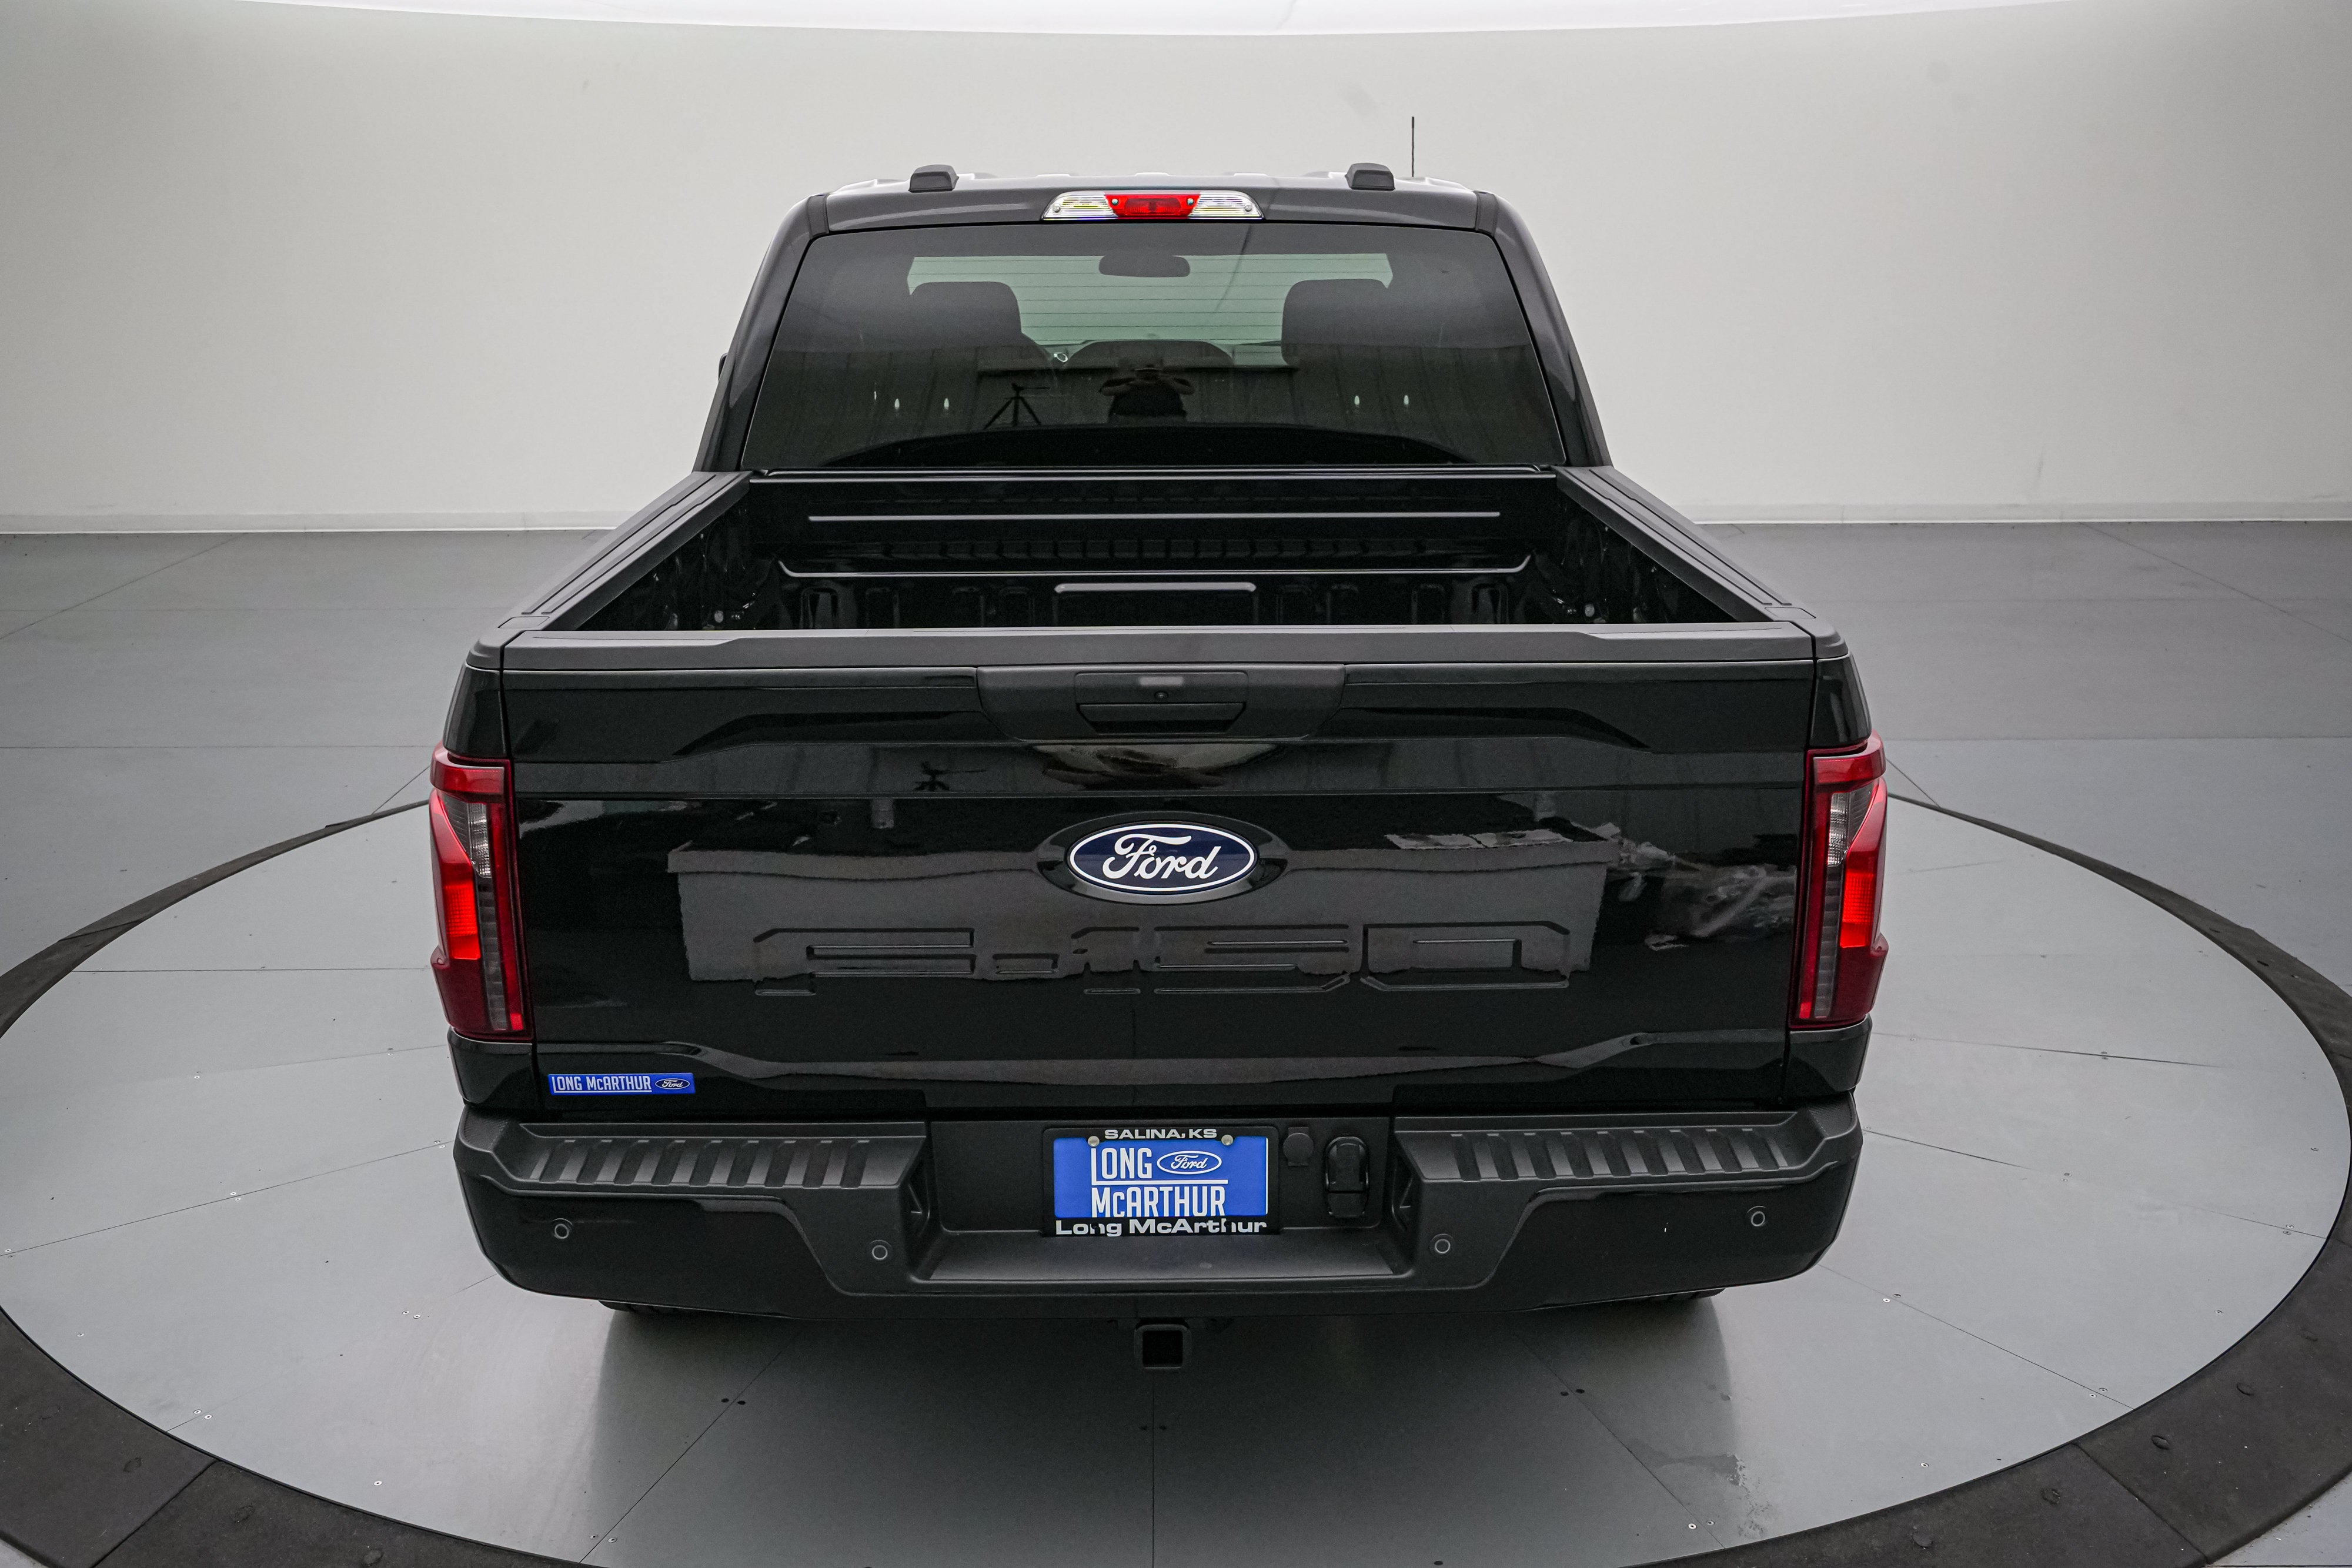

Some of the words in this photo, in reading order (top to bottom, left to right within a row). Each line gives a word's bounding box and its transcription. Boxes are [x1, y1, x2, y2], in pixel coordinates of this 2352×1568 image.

[1102, 833, 1222, 880] Ford
[552, 1076, 582, 1092] LONG
[586, 1075, 652, 1090] McARTHUR
[662, 1079, 683, 1088] Ford
[1091, 1148, 1152, 1185] LONG
[1170, 1154, 1207, 1169] Ford
[1091, 1186, 1226, 1218] McARTHUR
[1055, 1220, 1122, 1237] Long
[1129, 1219, 1267, 1234] McArthur
